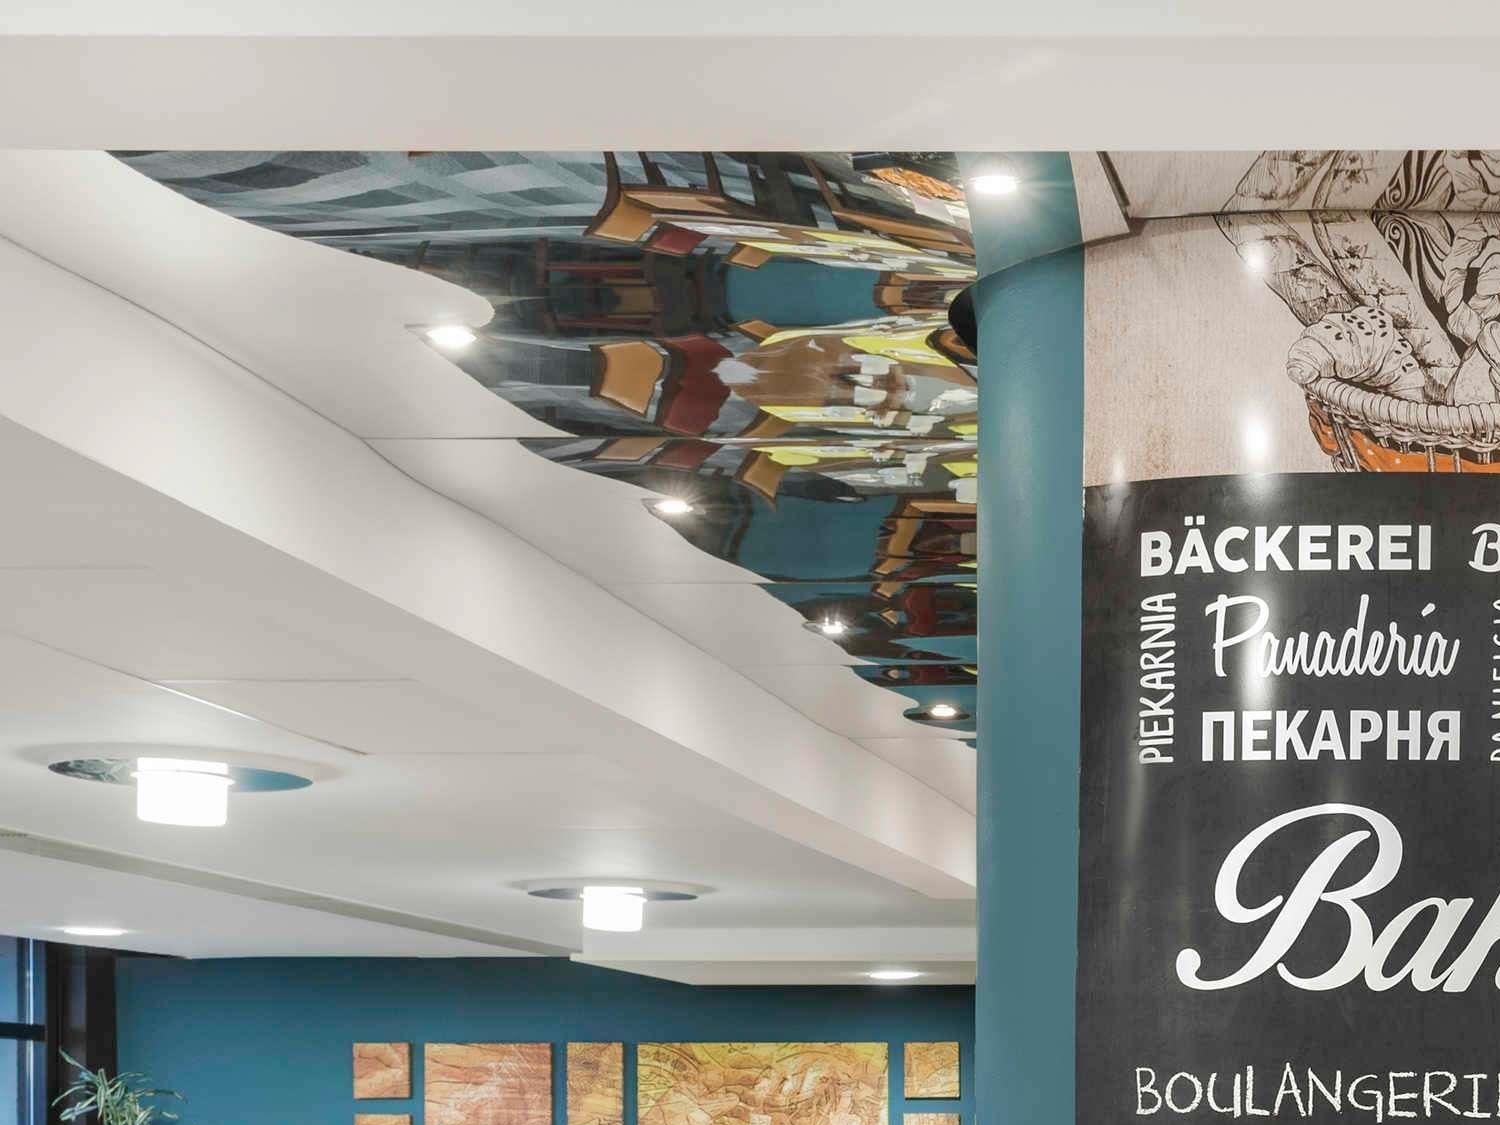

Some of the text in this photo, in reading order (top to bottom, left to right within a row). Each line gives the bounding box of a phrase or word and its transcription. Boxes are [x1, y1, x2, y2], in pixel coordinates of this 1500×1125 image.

[1140, 515, 1432, 577] BÄCKEREI
[1205, 593, 1461, 678] Panadería
[1137, 592, 1177, 764] PIEKARNIA
[1201, 709, 1461, 762] ПЕКАРНЯ
